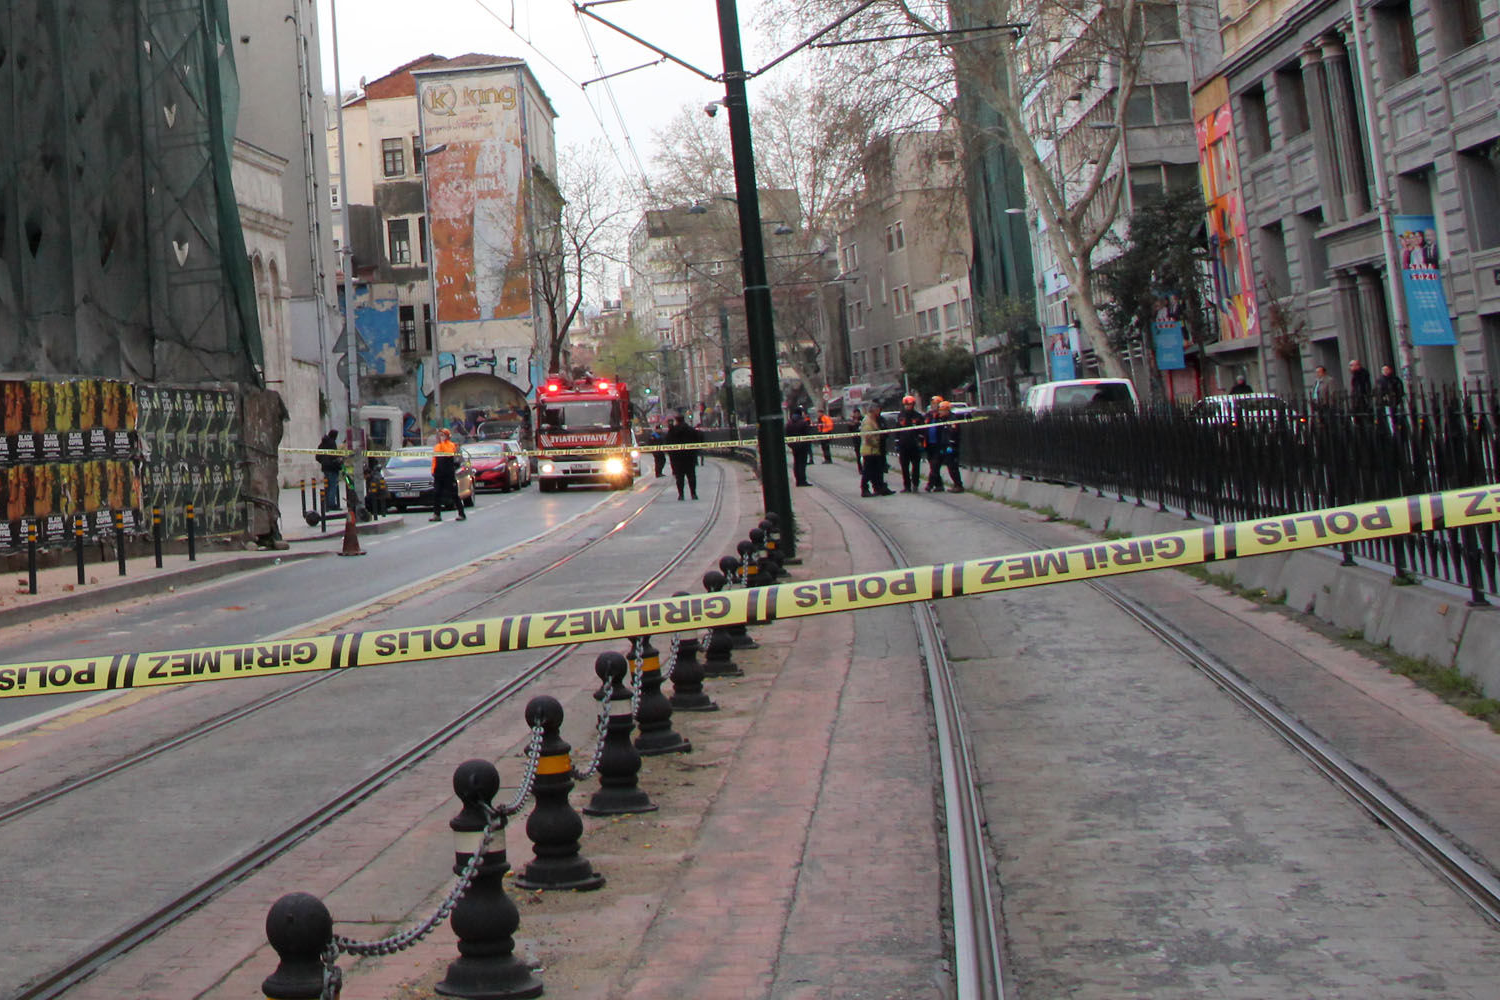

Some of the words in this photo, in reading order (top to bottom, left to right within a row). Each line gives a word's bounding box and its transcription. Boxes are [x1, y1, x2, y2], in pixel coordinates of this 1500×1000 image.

[463, 87, 516, 110] king
[1255, 508, 1392, 545] POLİS
[982, 538, 1185, 584] GİRİLMEZ
[794, 574, 916, 607] POLİS
[544, 595, 730, 638] GİRİLMEZ
[375, 625, 485, 656] POLİS
[148, 643, 317, 679] GİRİLMEZ
